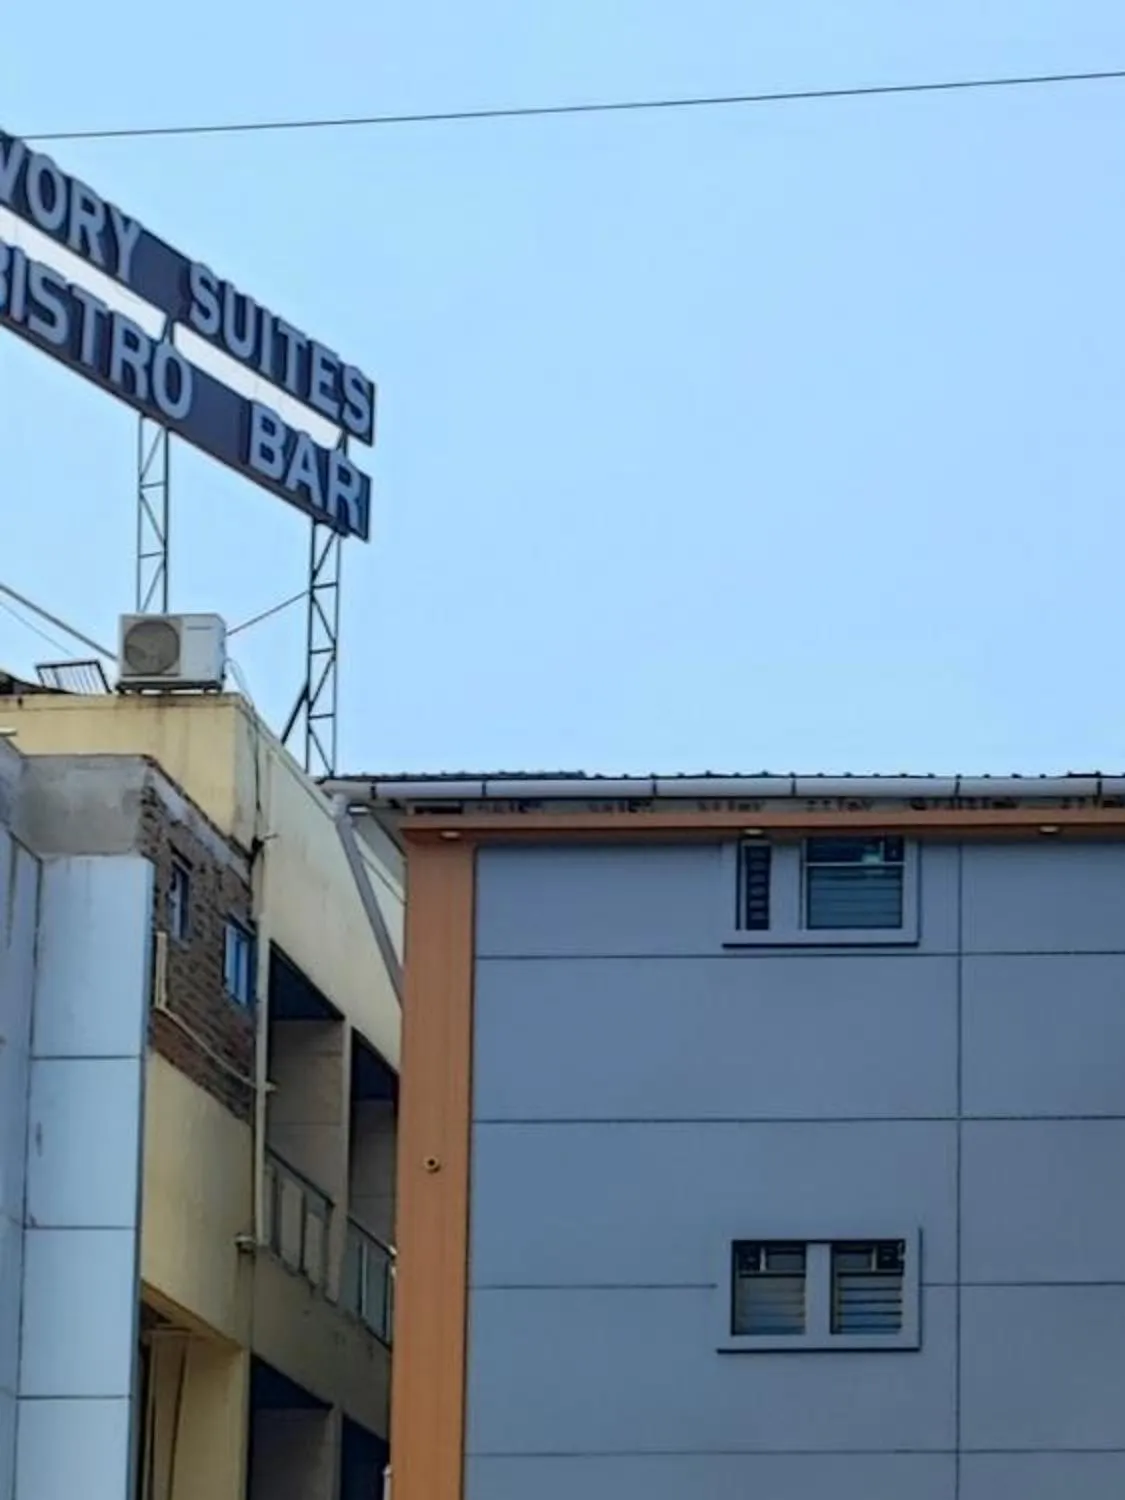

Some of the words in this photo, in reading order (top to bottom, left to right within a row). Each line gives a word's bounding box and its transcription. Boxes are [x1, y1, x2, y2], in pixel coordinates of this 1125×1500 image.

[0, 239, 193, 419] ISTRO
[248, 401, 362, 532] BAR
[189, 263, 371, 434] SUITES
